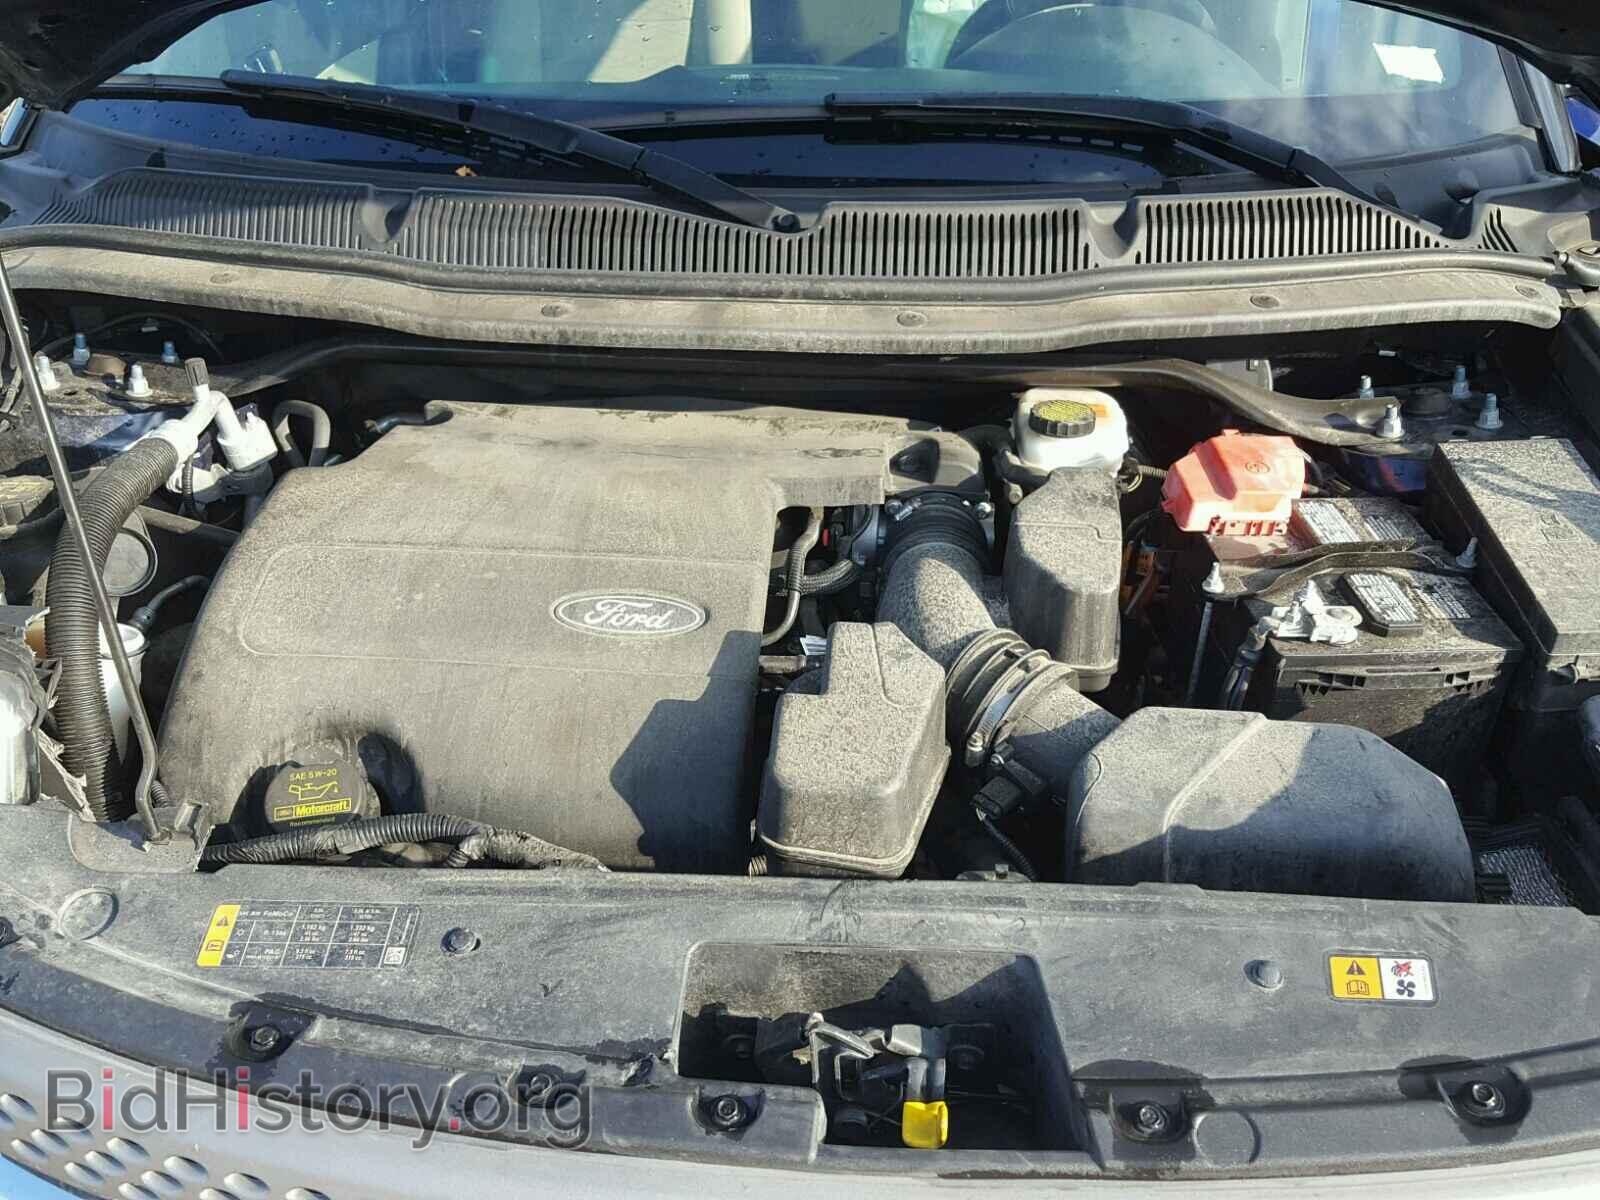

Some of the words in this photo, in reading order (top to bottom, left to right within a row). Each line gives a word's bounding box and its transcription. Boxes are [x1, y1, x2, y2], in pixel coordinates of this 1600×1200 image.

[583, 599, 674, 629] Ford
[290, 771, 307, 781] SAE
[296, 800, 349, 817] Motorcraft
